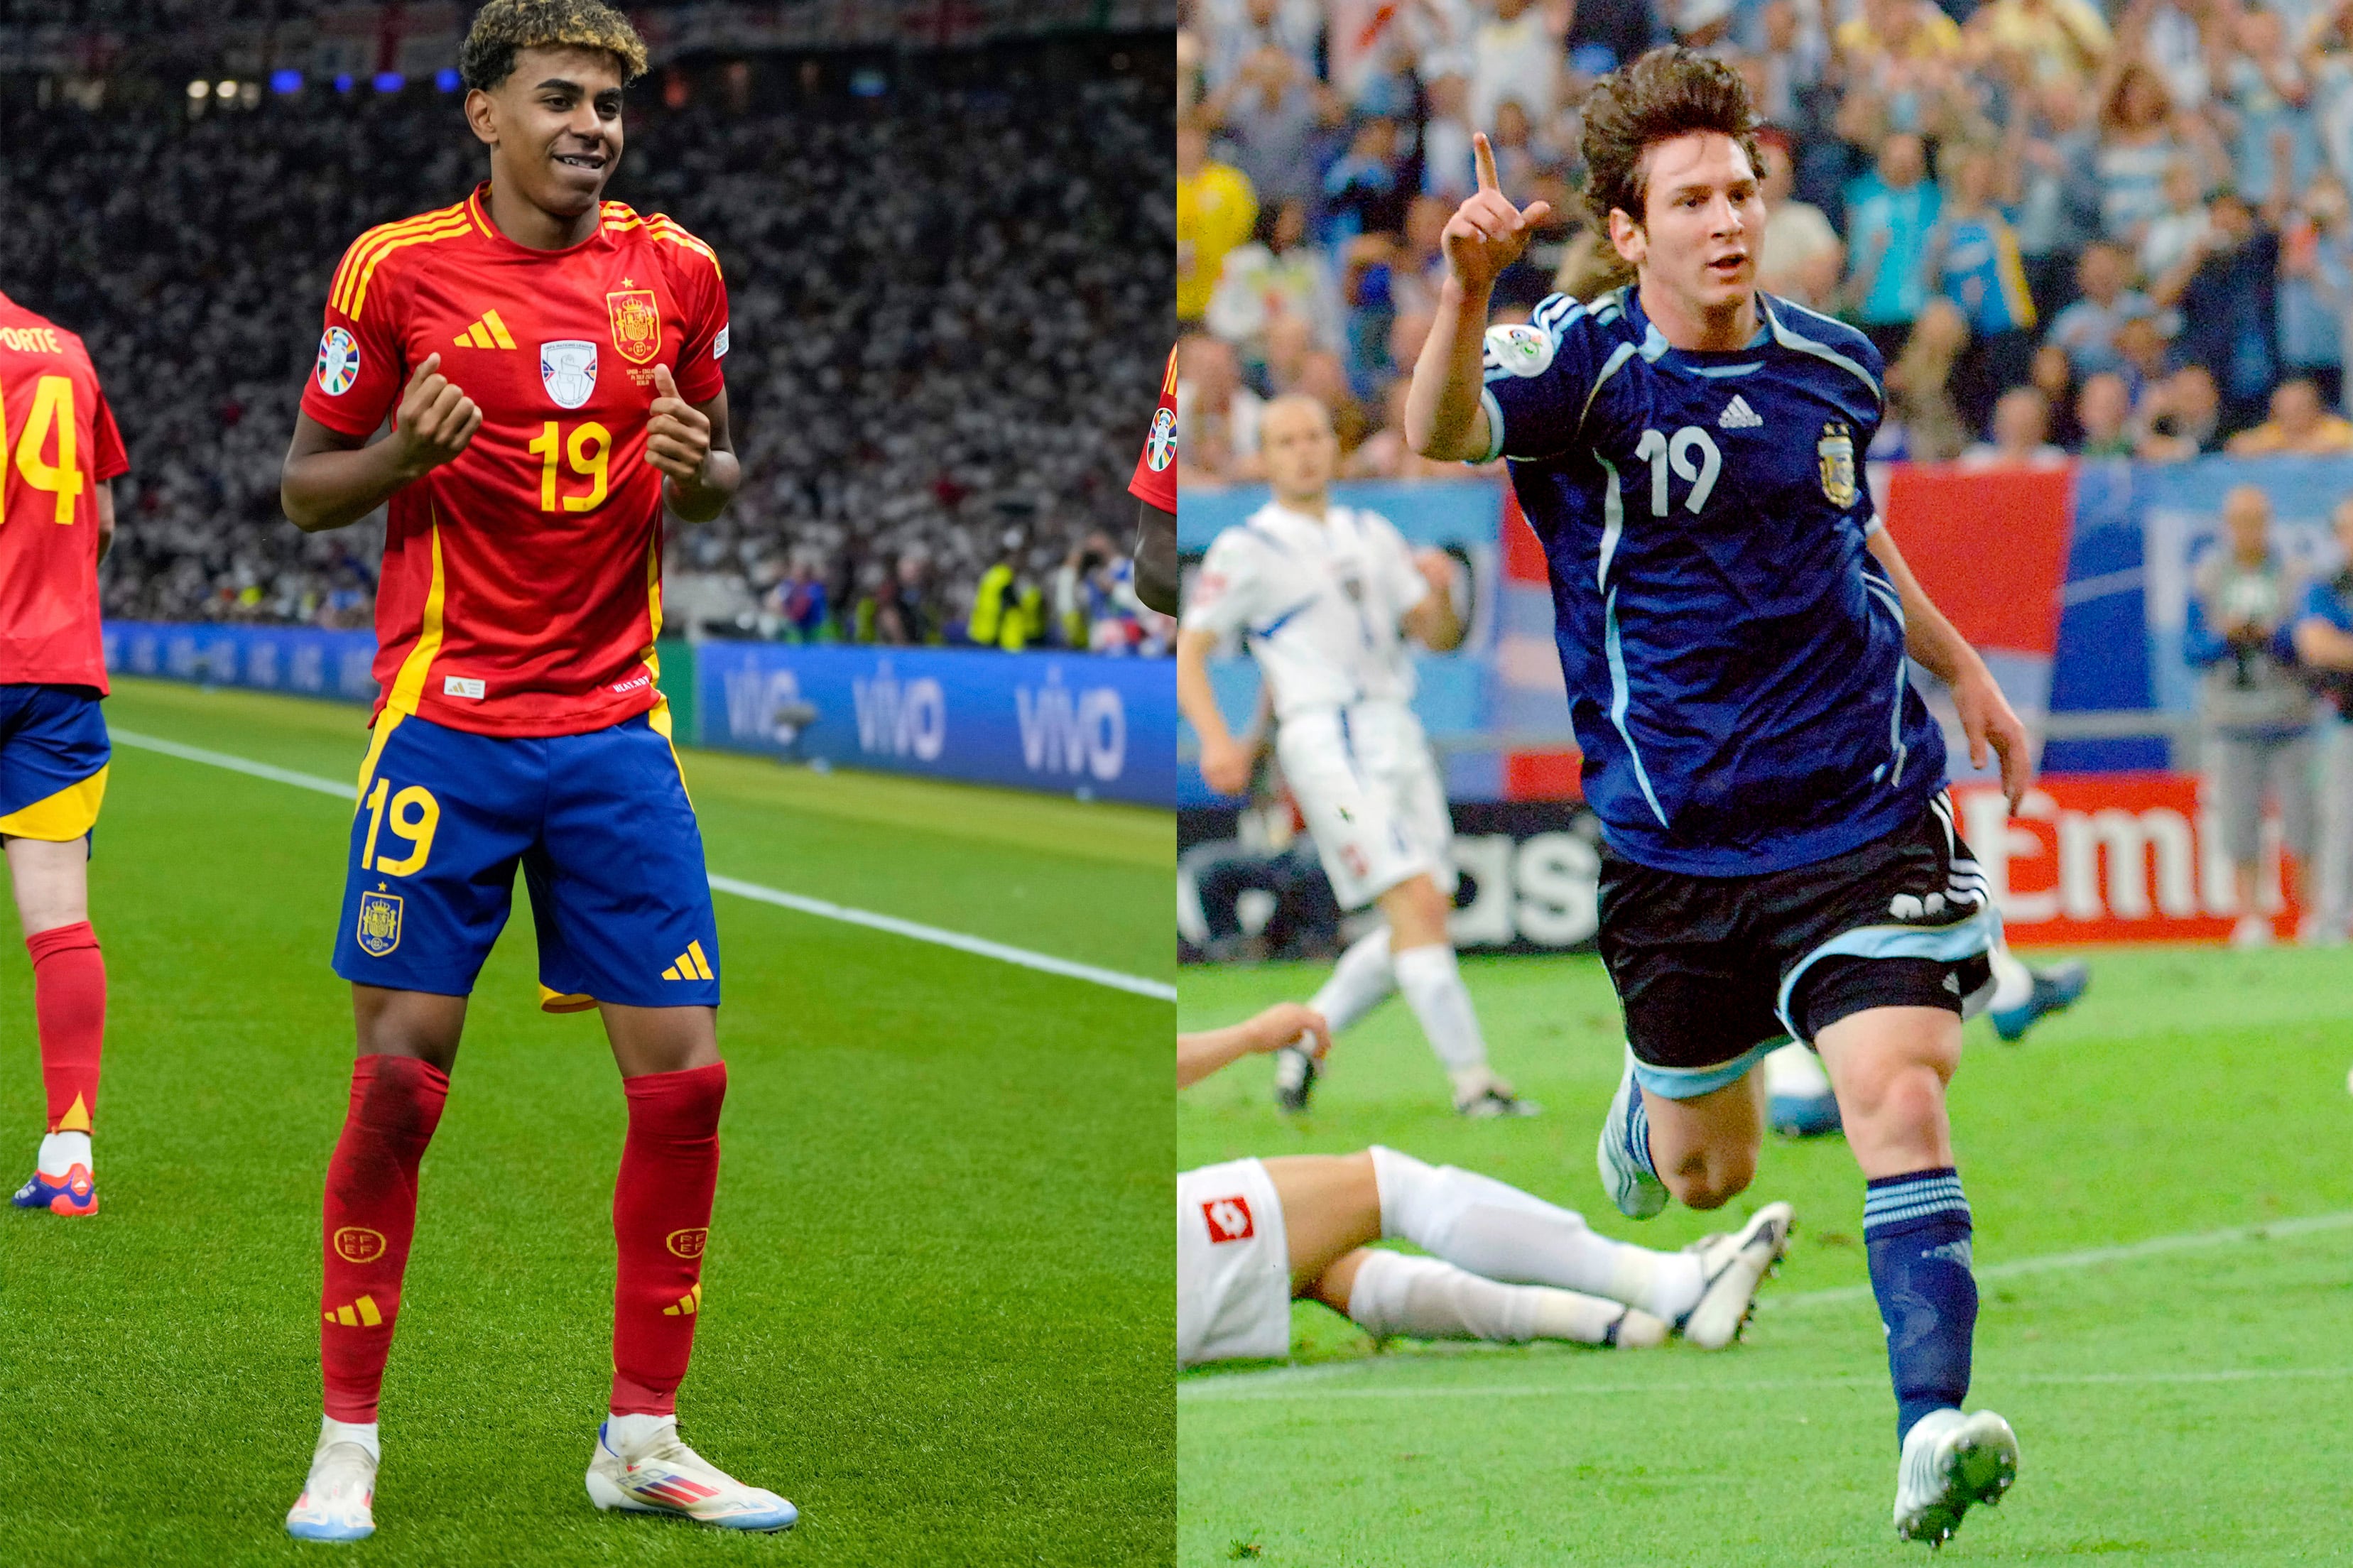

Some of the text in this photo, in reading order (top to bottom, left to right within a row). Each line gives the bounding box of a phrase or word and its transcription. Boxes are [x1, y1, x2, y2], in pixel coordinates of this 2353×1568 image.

[0, 327, 63, 354] ORTE
[529, 421, 612, 512] 19
[1634, 425, 1722, 518] 19
[613, 675, 650, 693] HEAT.RDY
[1016, 665, 1126, 781] vivo
[361, 778, 440, 878] 19
